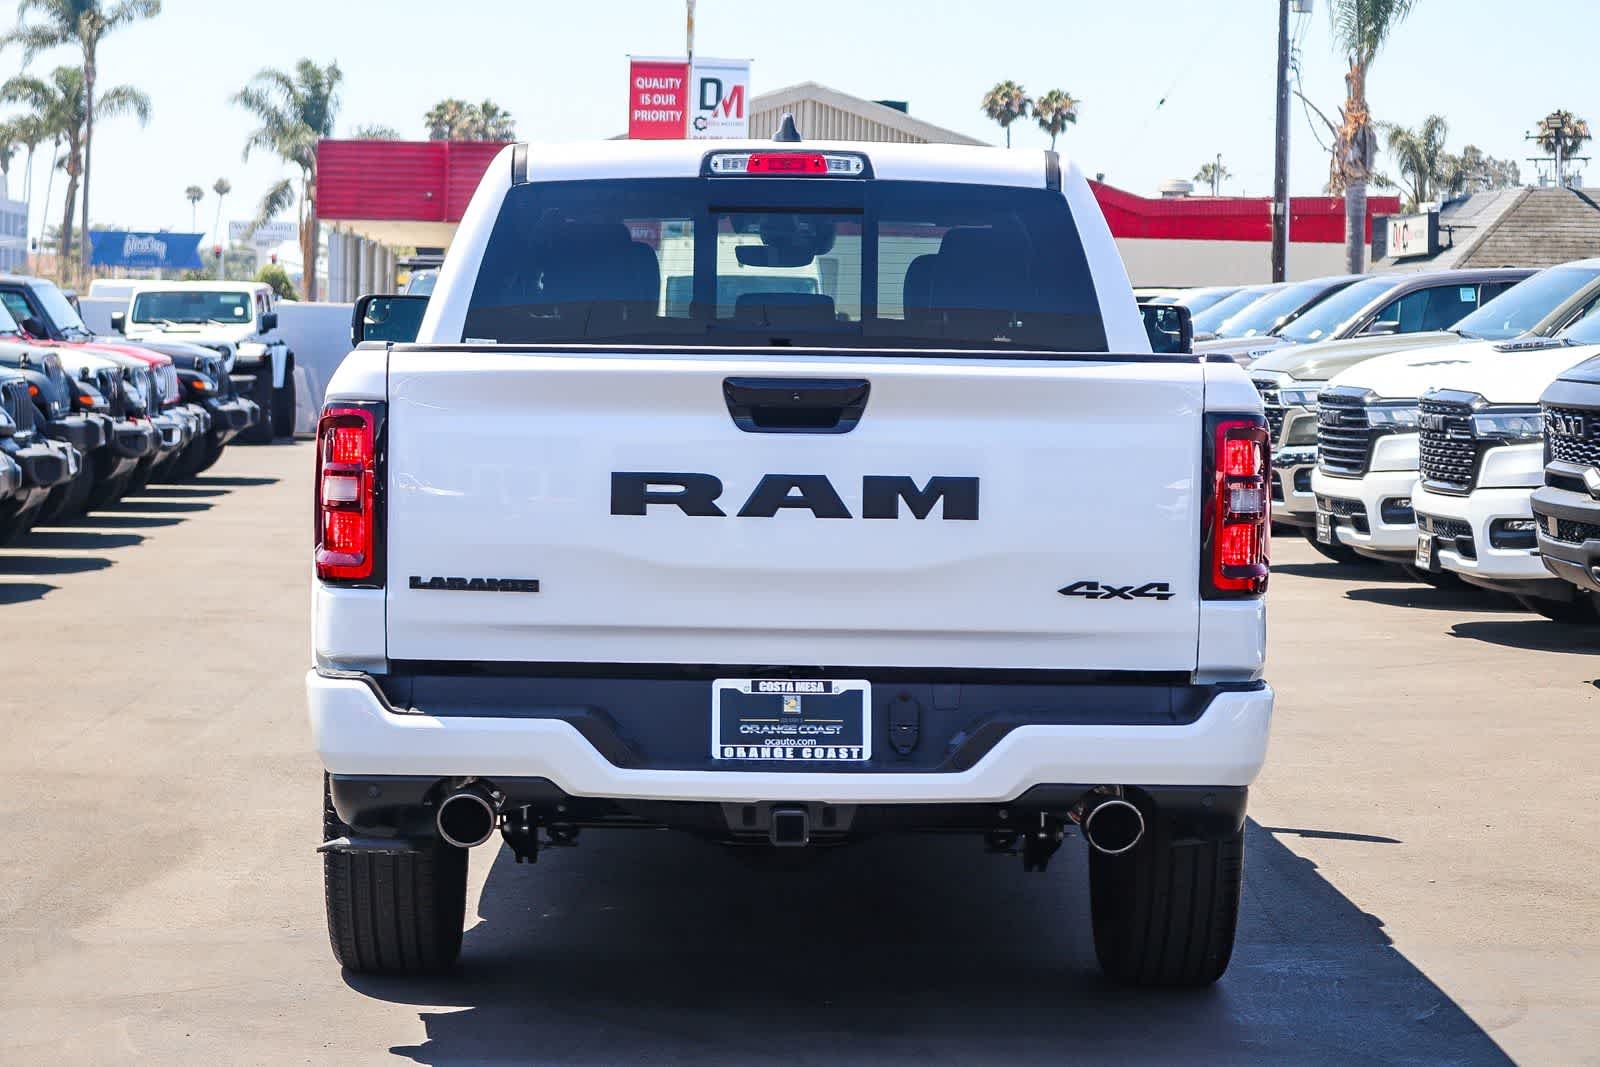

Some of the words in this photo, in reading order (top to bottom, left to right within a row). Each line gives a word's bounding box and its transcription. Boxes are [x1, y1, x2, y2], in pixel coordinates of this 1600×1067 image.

[636, 77, 682, 90] QUALITY
[641, 94, 651, 105] IS
[653, 94, 676, 105] OUR
[634, 110, 683, 123] PRIORITY
[610, 471, 980, 520] RAM
[409, 576, 540, 592] LARAMIE
[1057, 581, 1176, 600] 4x4
[759, 681, 796, 693] COSTA
[798, 681, 825, 693] MESA
[739, 724, 798, 734] ORANGE
[798, 725, 843, 735] COAST
[765, 737, 816, 746] ocauto.com
[723, 747, 794, 759] ORANGE
[802, 747, 860, 759] COAST
